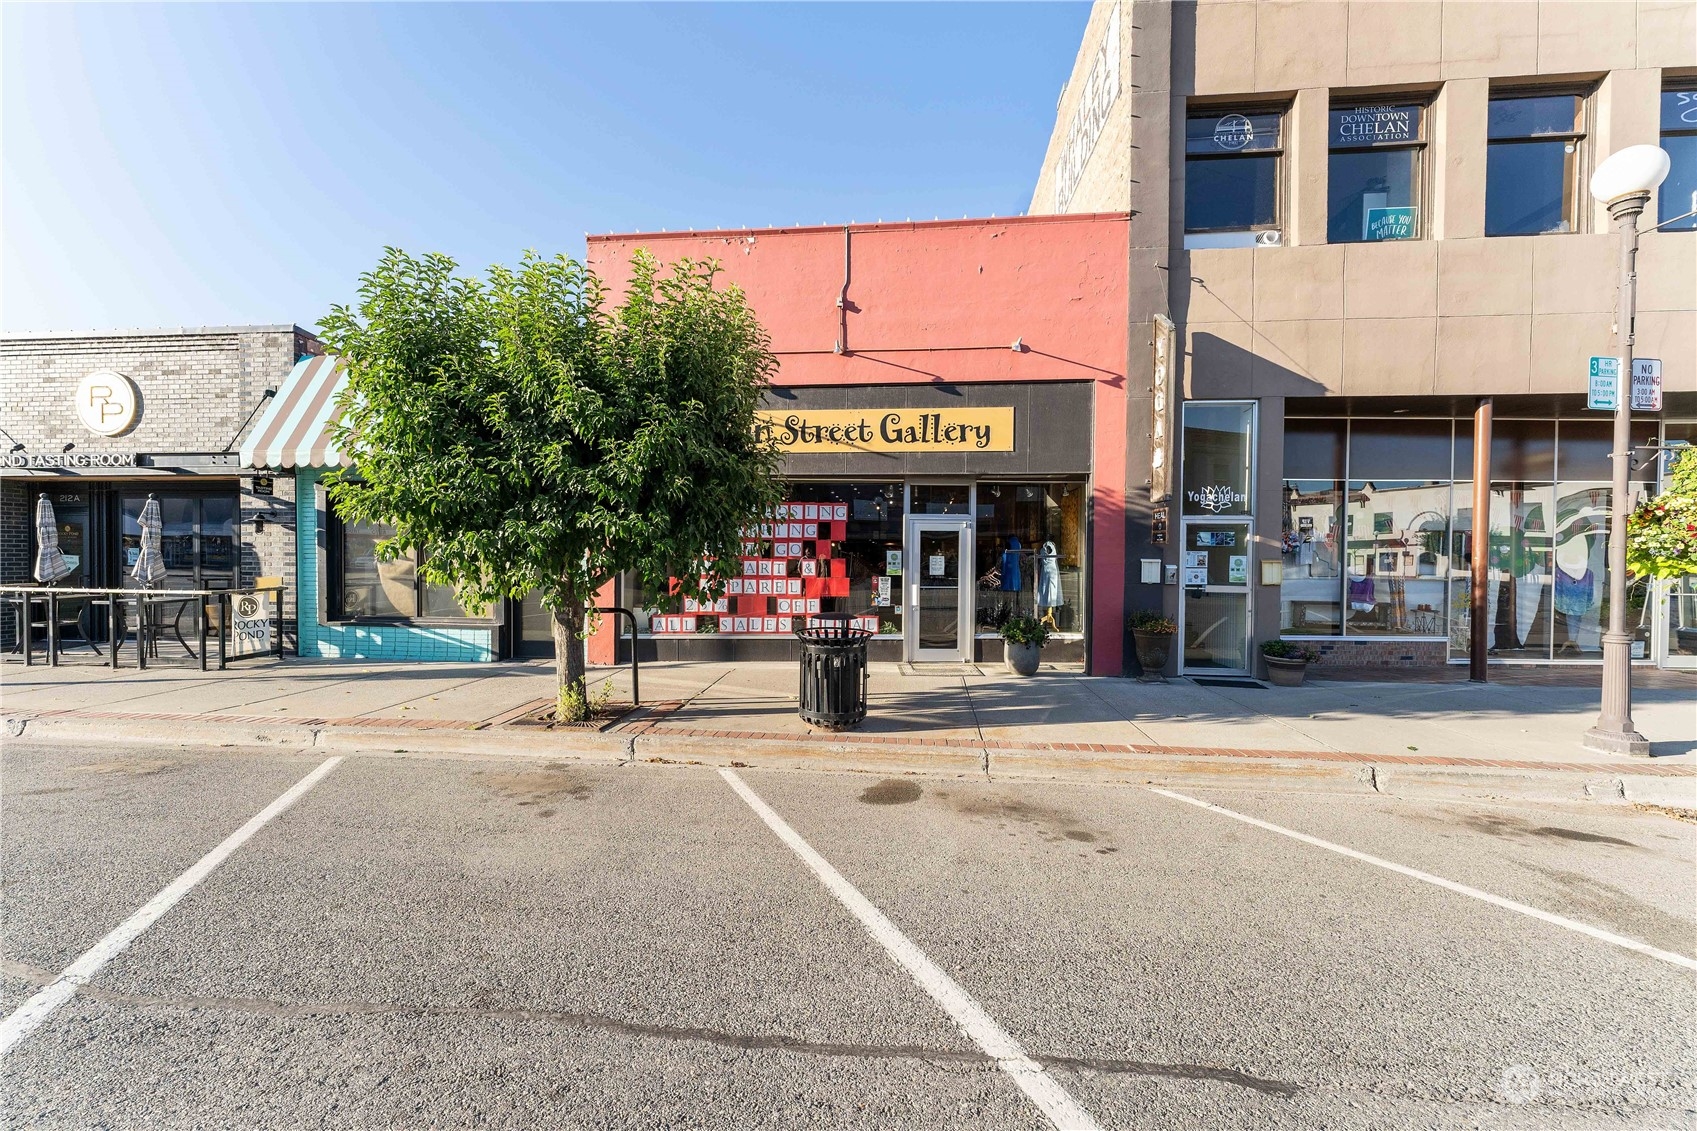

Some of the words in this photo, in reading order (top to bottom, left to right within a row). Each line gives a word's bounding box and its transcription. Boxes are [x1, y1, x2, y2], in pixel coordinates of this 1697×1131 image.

[1355, 105, 1396, 114] HISTORIC
[1341, 112, 1409, 123] DOWNTOWN
[1340, 121, 1410, 136] CHELAN
[1213, 134, 1254, 142] CHELAN
[1340, 132, 1409, 142] ASSOCIATION
[1398, 215, 1412, 225] YOU
[1376, 225, 1407, 239] MATTER
[1591, 360, 1598, 374] 3
[1641, 364, 1653, 374] NO
[1633, 375, 1660, 386] PARKING
[781, 414, 873, 445] Street
[880, 413, 990, 448] Gallery
[28, 453, 86, 467] TASTING
[90, 453, 134, 466] ROOM
[60, 494, 81, 502] 212A
[776, 545, 801, 556] GO
[745, 563, 784, 574] ART
[805, 563, 813, 574] &
[779, 601, 816, 611] OFF
[655, 619, 693, 631] ALL
[721, 619, 787, 631] SALES
